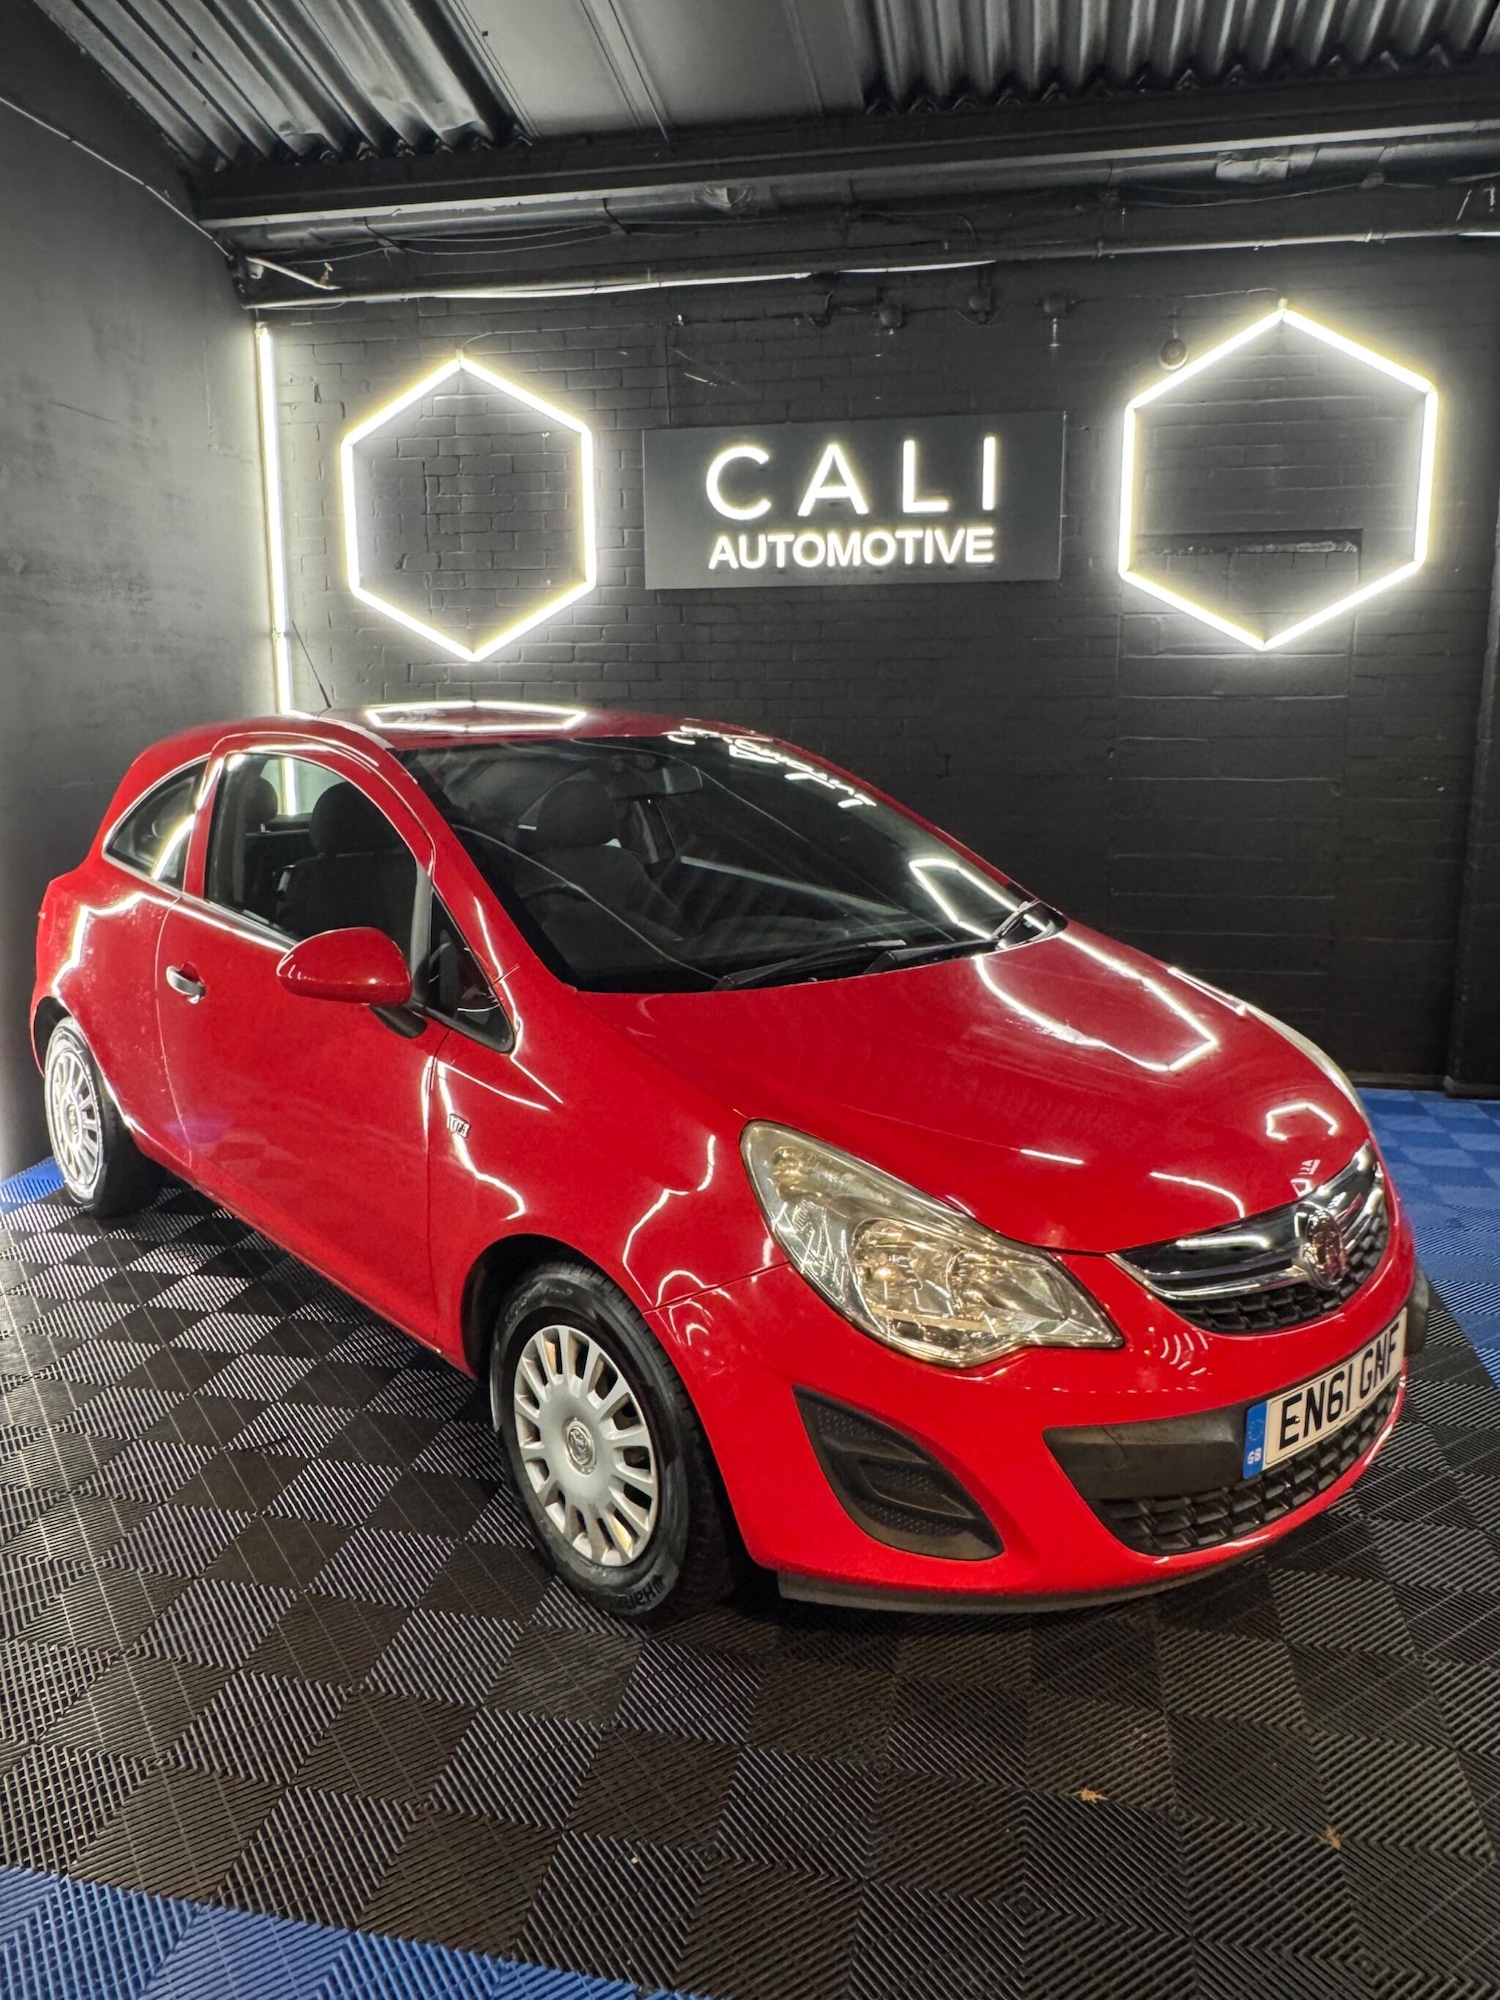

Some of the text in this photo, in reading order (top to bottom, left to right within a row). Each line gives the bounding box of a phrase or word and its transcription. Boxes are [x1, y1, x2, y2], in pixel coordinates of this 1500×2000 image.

[705, 436, 996, 520] CALI
[708, 526, 995, 569] AUTOMOTIVE
[1279, 1321, 1400, 1451] EN61 GNF
[1247, 1447, 1262, 1465] GB
